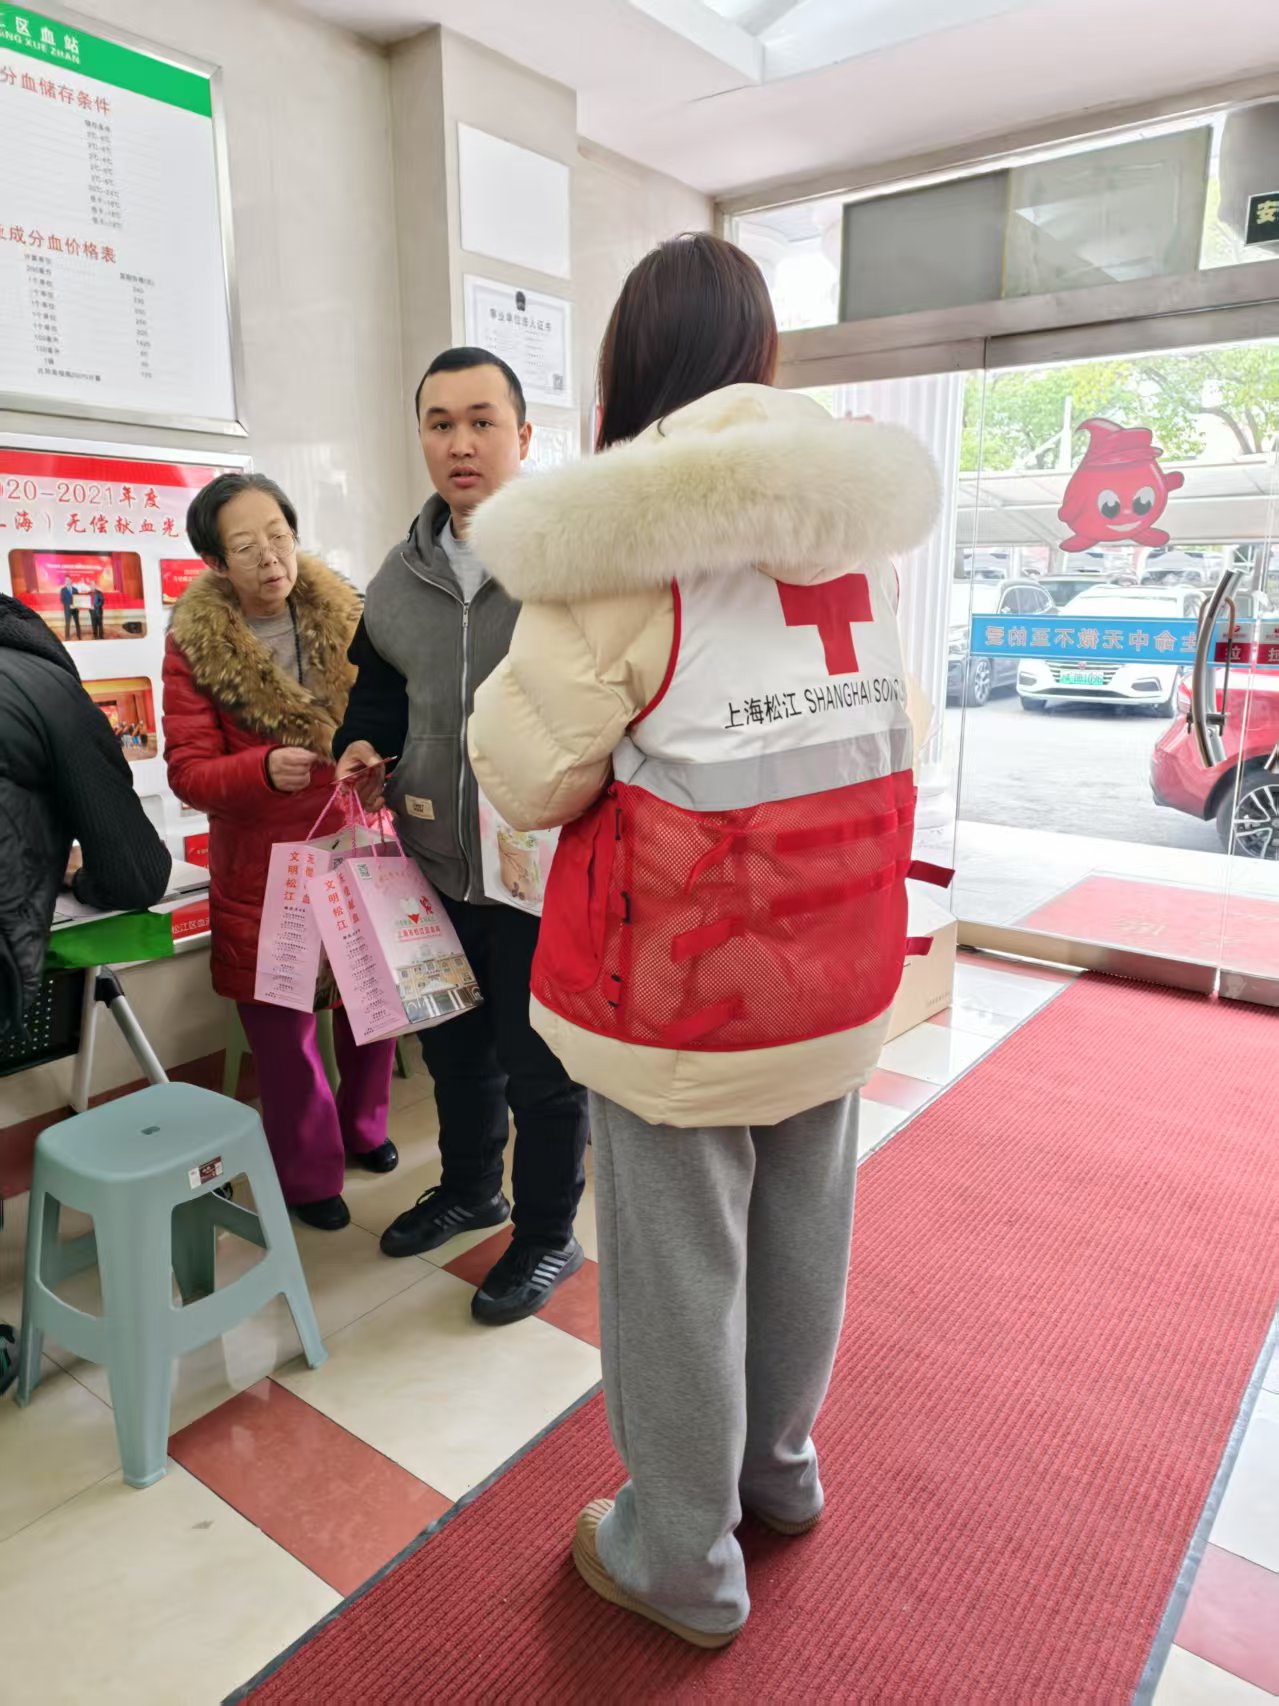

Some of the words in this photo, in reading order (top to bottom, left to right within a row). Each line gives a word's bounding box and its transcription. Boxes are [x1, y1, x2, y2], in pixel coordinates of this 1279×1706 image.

[0, 65, 111, 115] 分血储存条件
[0, 479, 160, 509] 20-2021年度
[724, 692, 802, 729] 上海松江
[803, 680, 871, 714] SHANGHAI
[284, 851, 299, 901] 文明松江
[302, 853, 314, 904] 无偿血
[324, 880, 348, 931] 文明松江
